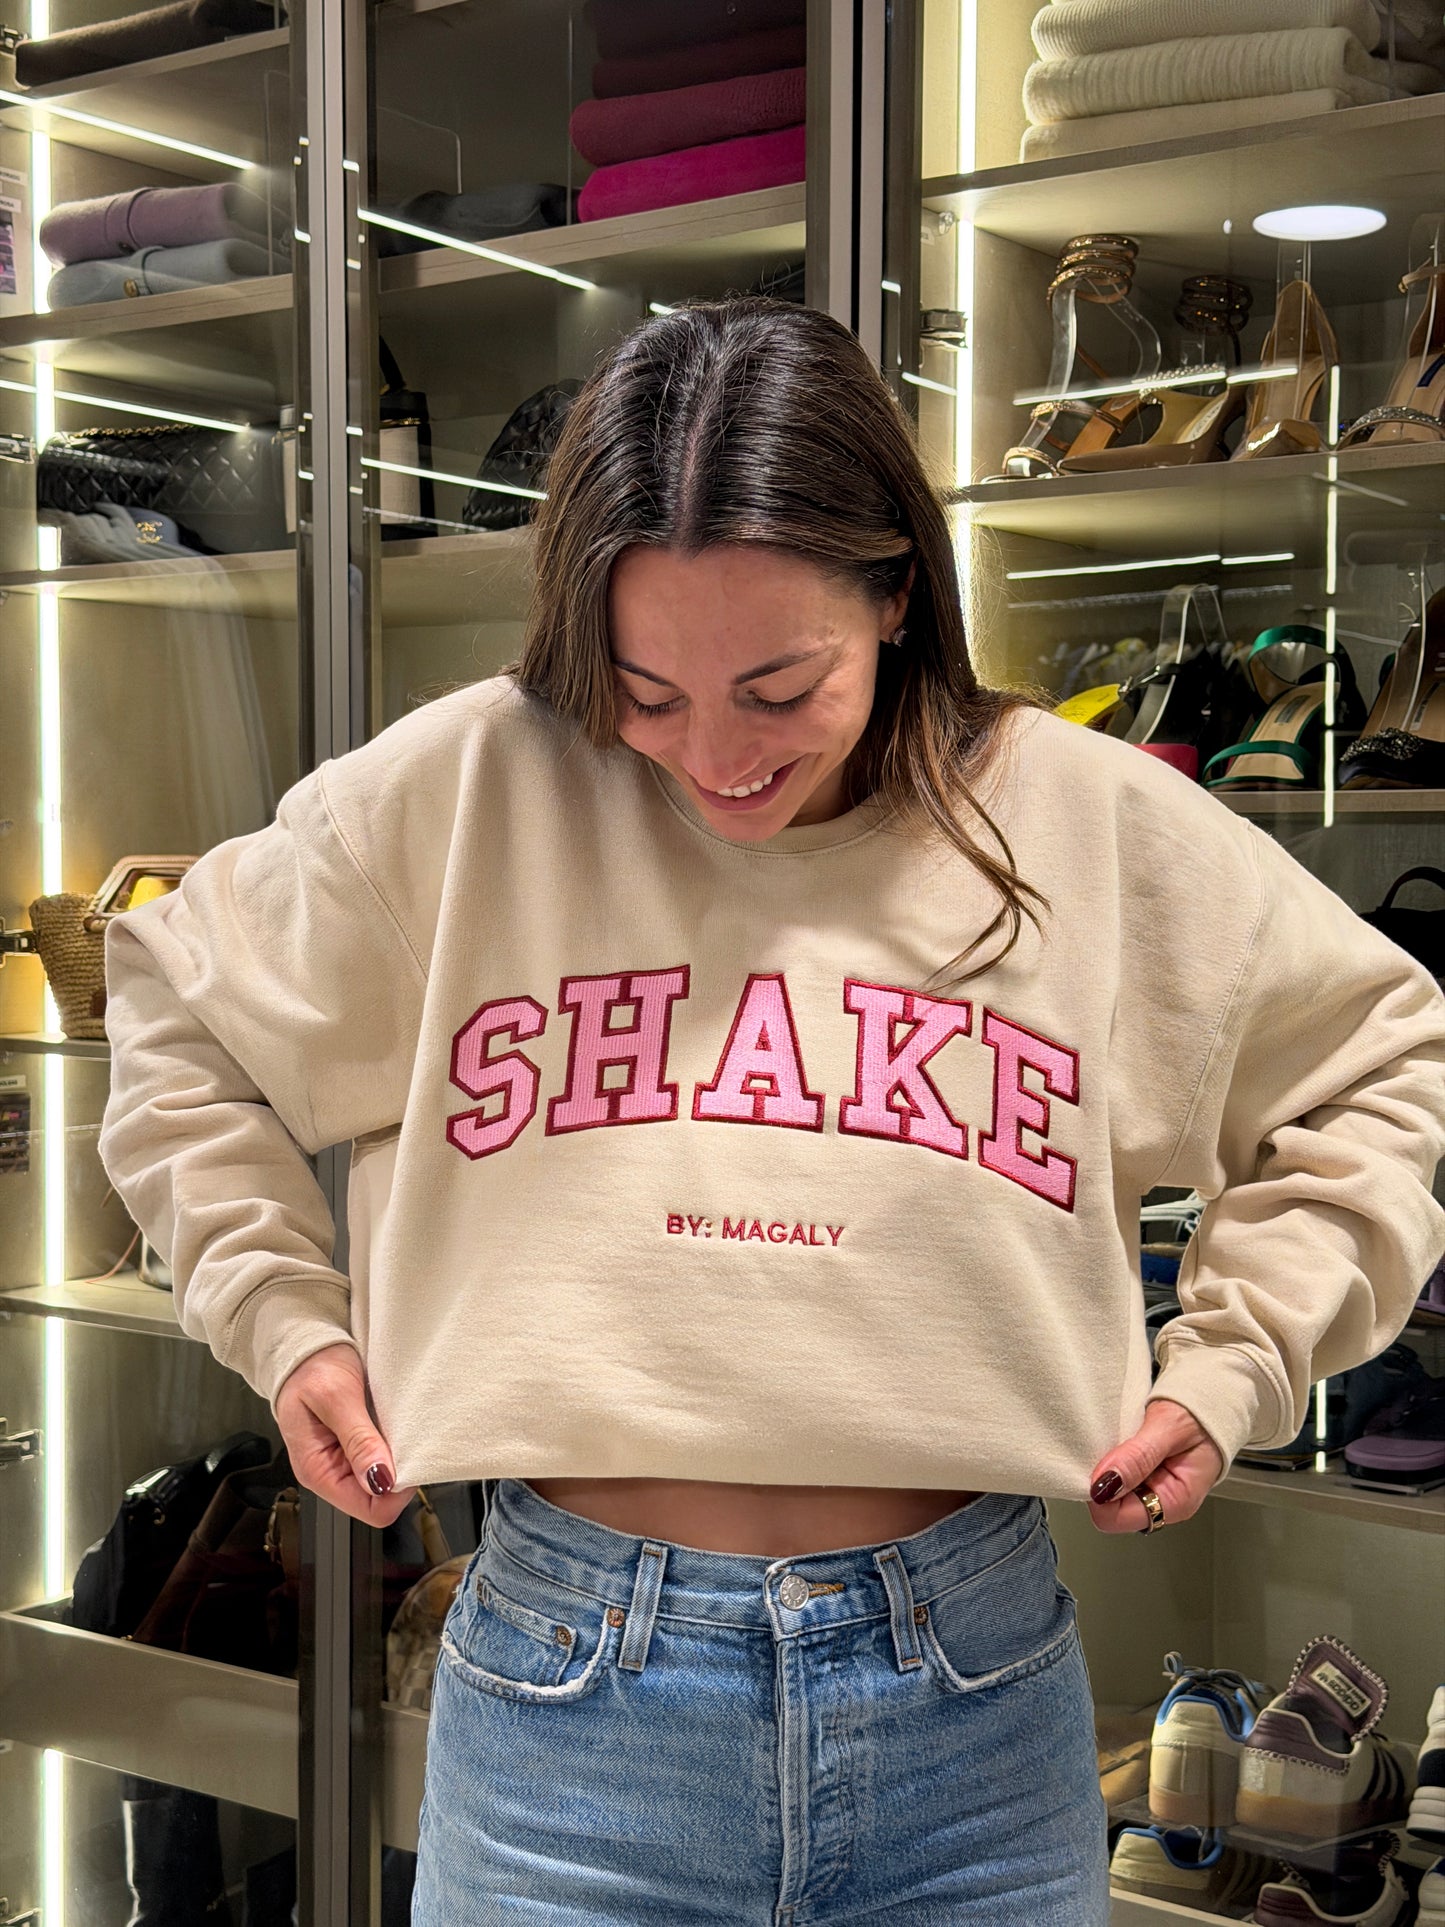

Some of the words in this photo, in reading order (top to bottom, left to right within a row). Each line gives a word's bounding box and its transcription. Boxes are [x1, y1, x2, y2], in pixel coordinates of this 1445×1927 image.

[446, 964, 1081, 1212] SHAKE
[666, 1212, 712, 1238] BY:
[721, 1217, 845, 1247] MAGALY
[1328, 1680, 1360, 1711] adidas
